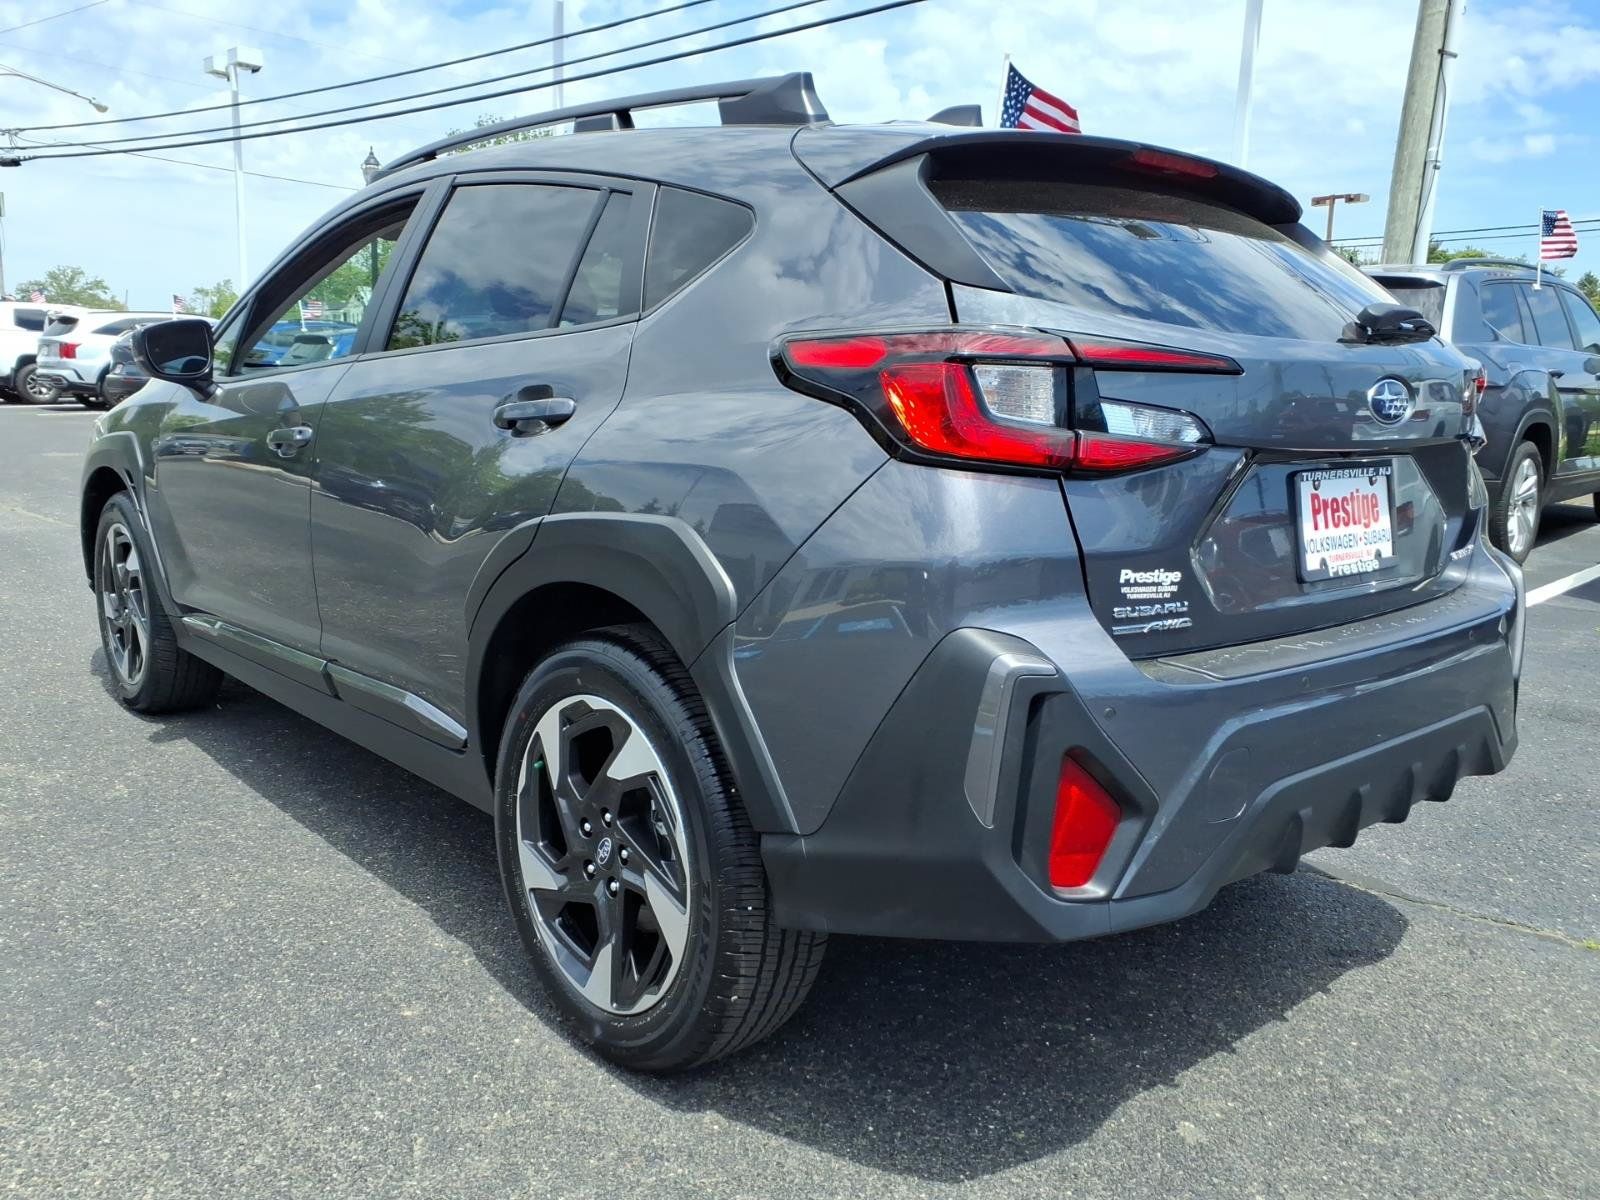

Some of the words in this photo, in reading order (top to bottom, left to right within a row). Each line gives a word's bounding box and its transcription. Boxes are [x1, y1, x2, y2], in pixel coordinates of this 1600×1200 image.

[1379, 467, 1391, 476] NJ
[1311, 489, 1379, 531] Prestige
[1363, 527, 1391, 546] SUBARU
[1328, 559, 1380, 577] Prestige
[1119, 568, 1182, 586] Prestige
[1120, 586, 1157, 594] VOLKSWAGEN
[1112, 601, 1189, 618] SUBARU
[1143, 617, 1193, 633] AWD
